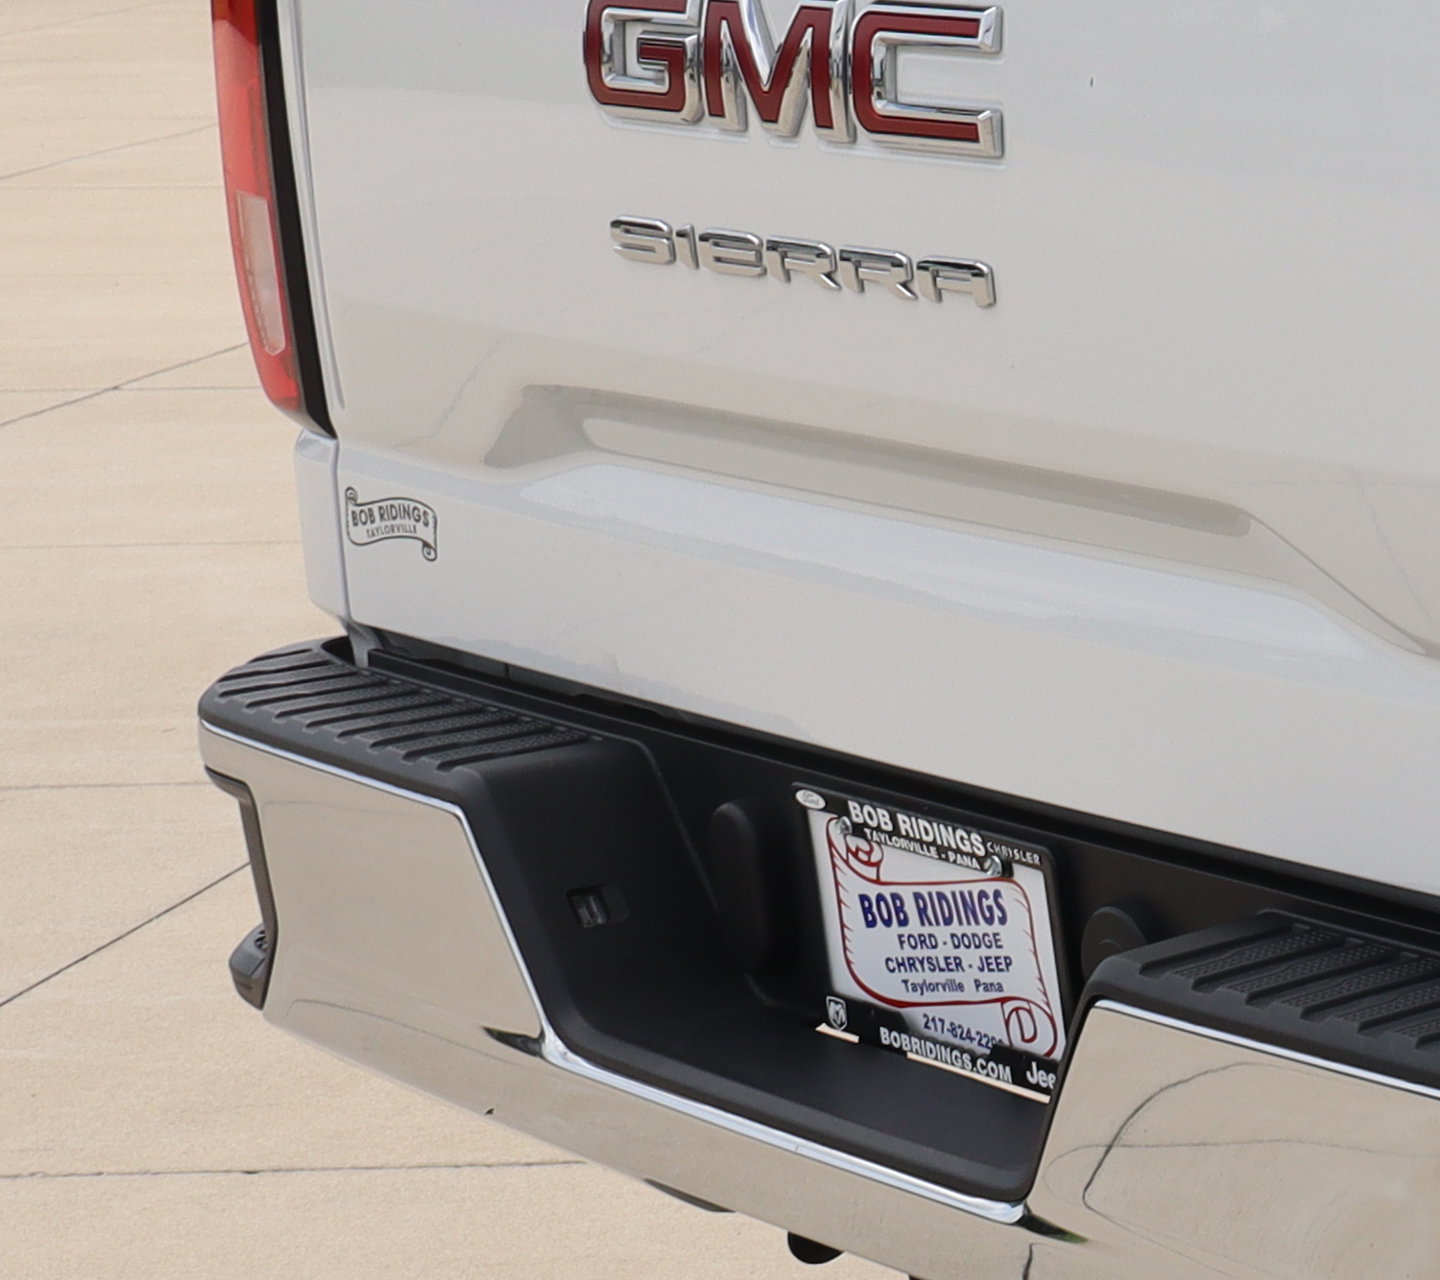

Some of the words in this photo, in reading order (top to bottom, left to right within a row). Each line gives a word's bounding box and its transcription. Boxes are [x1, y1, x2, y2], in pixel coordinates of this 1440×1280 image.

[610, 214, 996, 308] SIERRA
[351, 507, 376, 527] BOB
[377, 503, 430, 528] RIDINGS
[366, 524, 417, 538] TAYLORVILLE
[847, 800, 893, 832] BOB
[896, 813, 986, 857] RIDINGS
[863, 827, 939, 859] TAYLORVILLE
[949, 854, 981, 871] PANA
[986, 841, 1041, 866] CHRYSLER
[858, 892, 909, 929] BOB
[912, 888, 1008, 927] RIDINGS
[897, 932, 939, 951] FORD
[951, 931, 1004, 950] DODGE
[884, 955, 963, 974] CHRYSLER
[977, 955, 1013, 973] JEEP
[901, 978, 965, 997] Taylorville
[974, 978, 1005, 993] Pana
[879, 1026, 1013, 1084] BOBRIDINGS.COM
